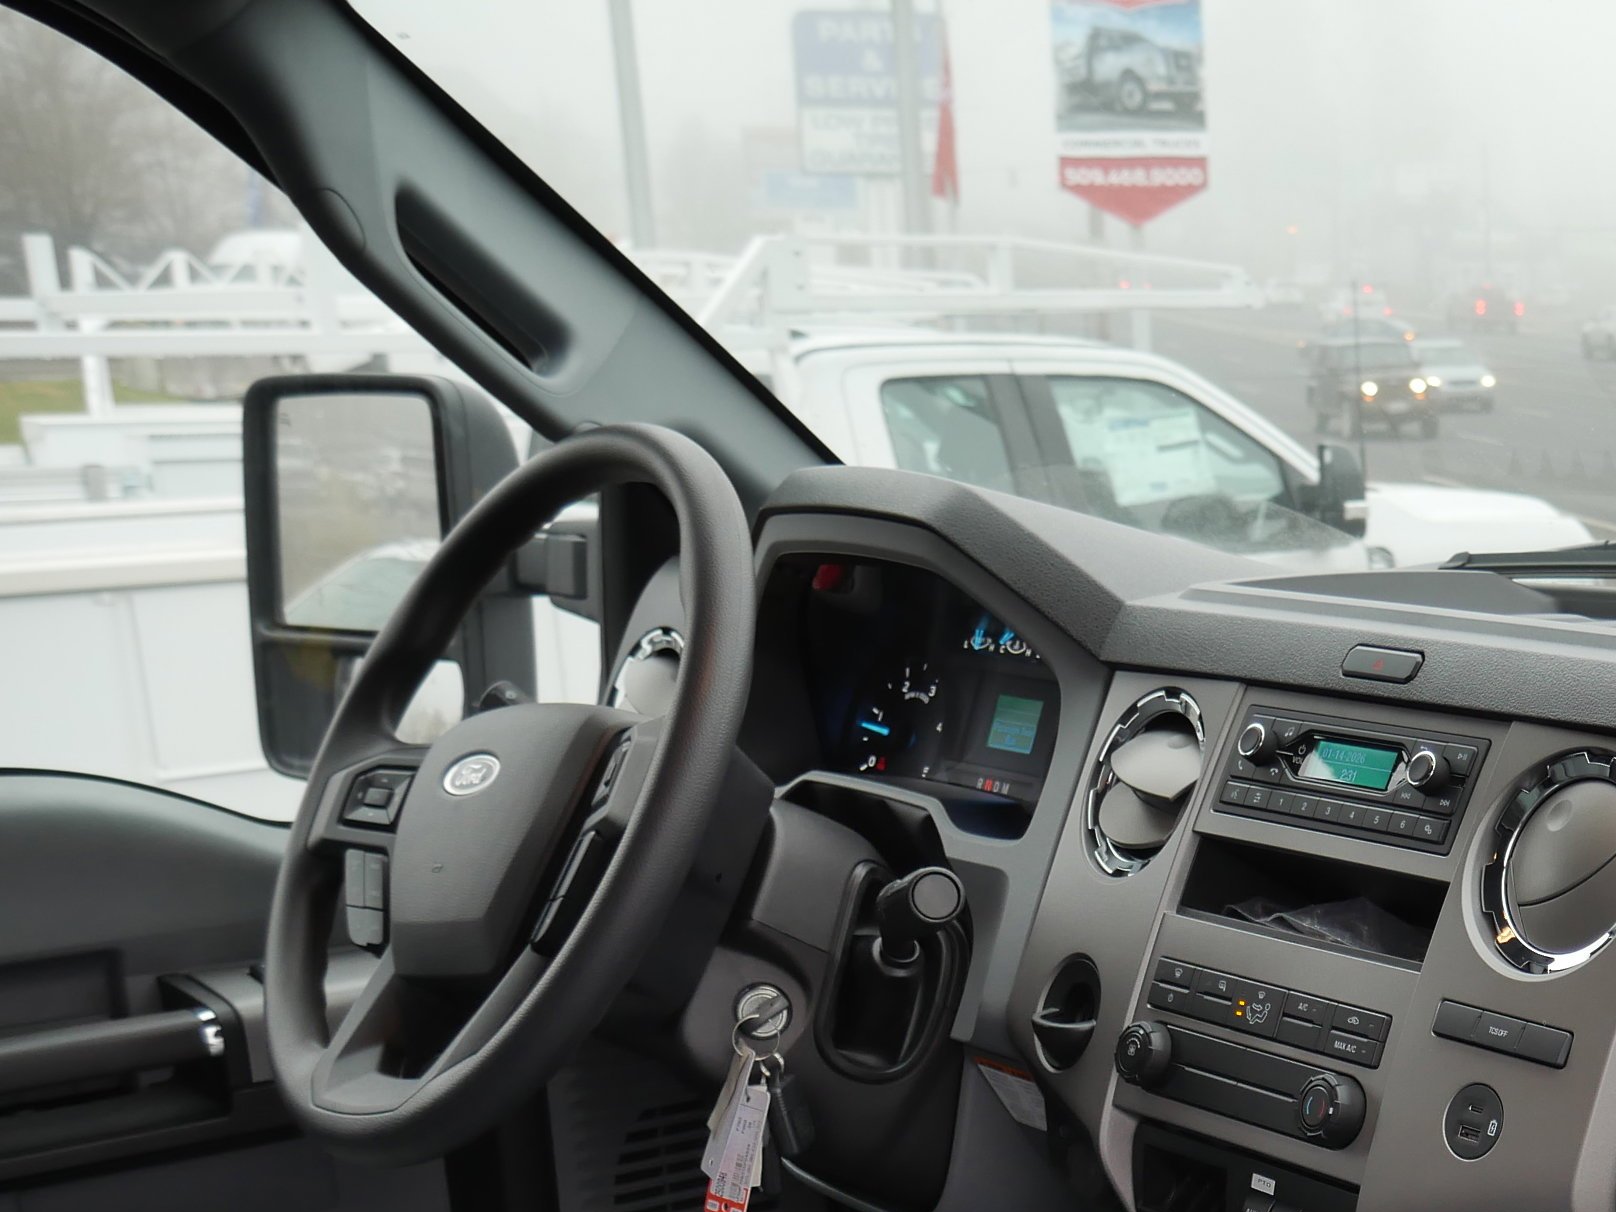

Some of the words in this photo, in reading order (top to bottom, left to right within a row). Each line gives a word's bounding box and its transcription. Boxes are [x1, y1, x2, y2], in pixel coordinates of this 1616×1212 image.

[868, 755, 877, 767] 0
[1301, 802, 1308, 811] 2
[1325, 806, 1331, 815] 3
[1349, 810, 1356, 819] 4
[1373, 815, 1379, 824] 5
[1399, 819, 1406, 829] 6
[1298, 1003, 1309, 1012] A/C
